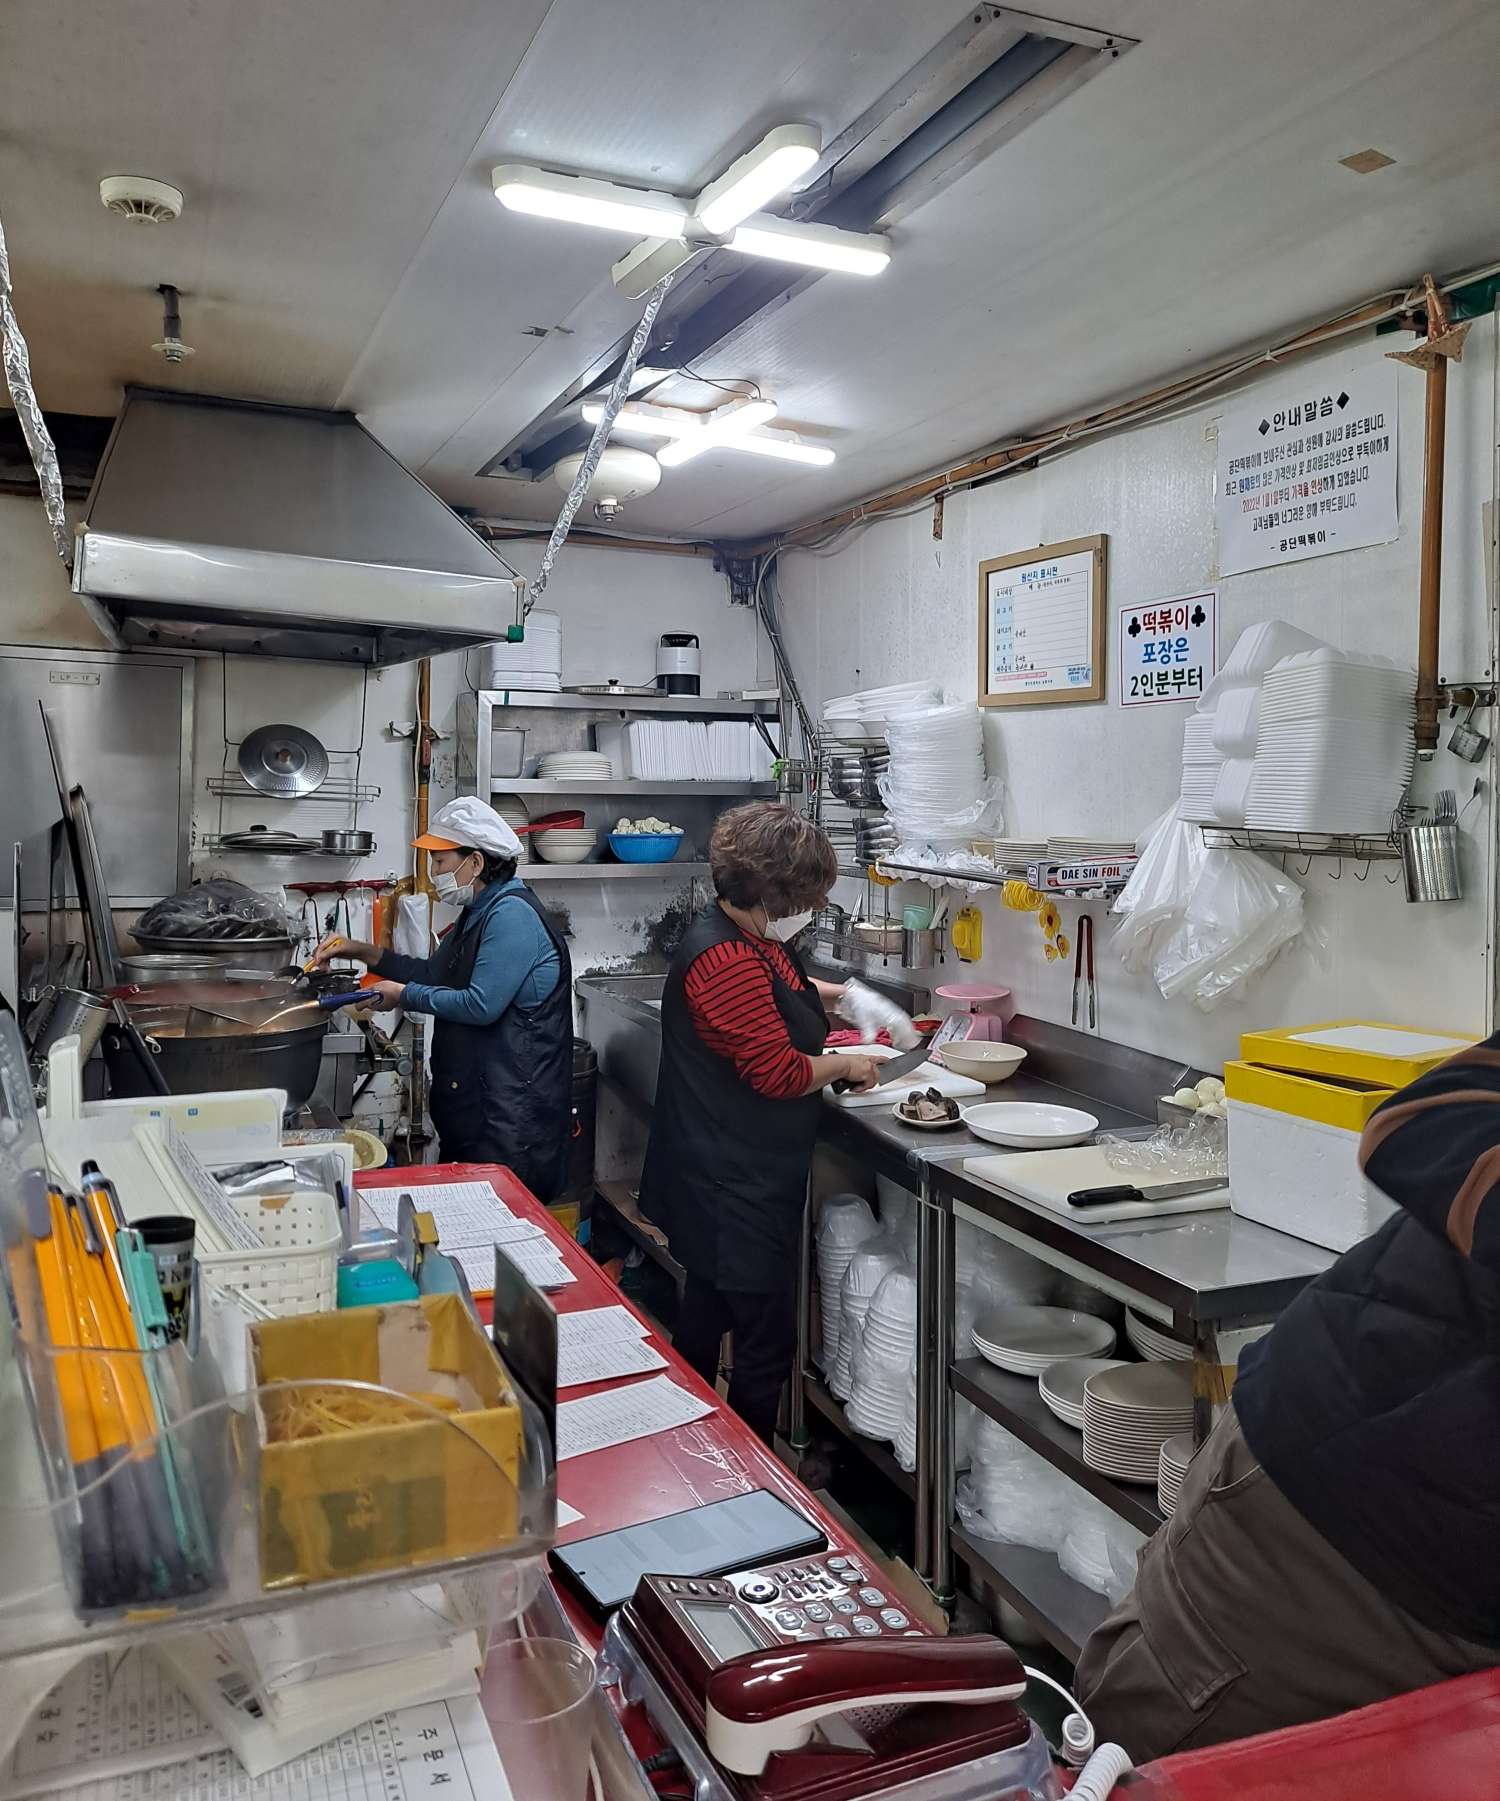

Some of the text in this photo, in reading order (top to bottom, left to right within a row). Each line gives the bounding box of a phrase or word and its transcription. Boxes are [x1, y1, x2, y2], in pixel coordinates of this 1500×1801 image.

[1273, 395, 1334, 433] 안내말씀
[1263, 444, 1285, 465] 보내주신
[1286, 439, 1304, 458] 관심과
[1305, 432, 1324, 453] 성원에
[1325, 426, 1344, 446] 감사의
[1345, 412, 1386, 440] 말씀드립니다.
[1225, 480, 1237, 496] 최근
[1239, 474, 1261, 494] 원재료의
[1274, 462, 1297, 484] 가격인상
[1306, 446, 1355, 474] 최저임금인상으로
[1356, 435, 1390, 460] 부득이하게
[1242, 495, 1261, 513] 2022년
[1291, 481, 1310, 499] 가격을
[1310, 474, 1336, 496] 인상하게
[1252, 492, 1358, 531] 고객님들의 너그러운 양해 부탁드립니다.
[1021, 570, 1039, 584] 원산지
[1040, 565, 1059, 579] 표시판
[1142, 604, 1189, 636] 떡볶이
[1141, 637, 1190, 665] 포장은
[1130, 665, 1203, 697] 2인분부터
[1061, 868, 1080, 880] DAE
[1082, 867, 1099, 879] SIN
[1101, 866, 1121, 877] FOIL
